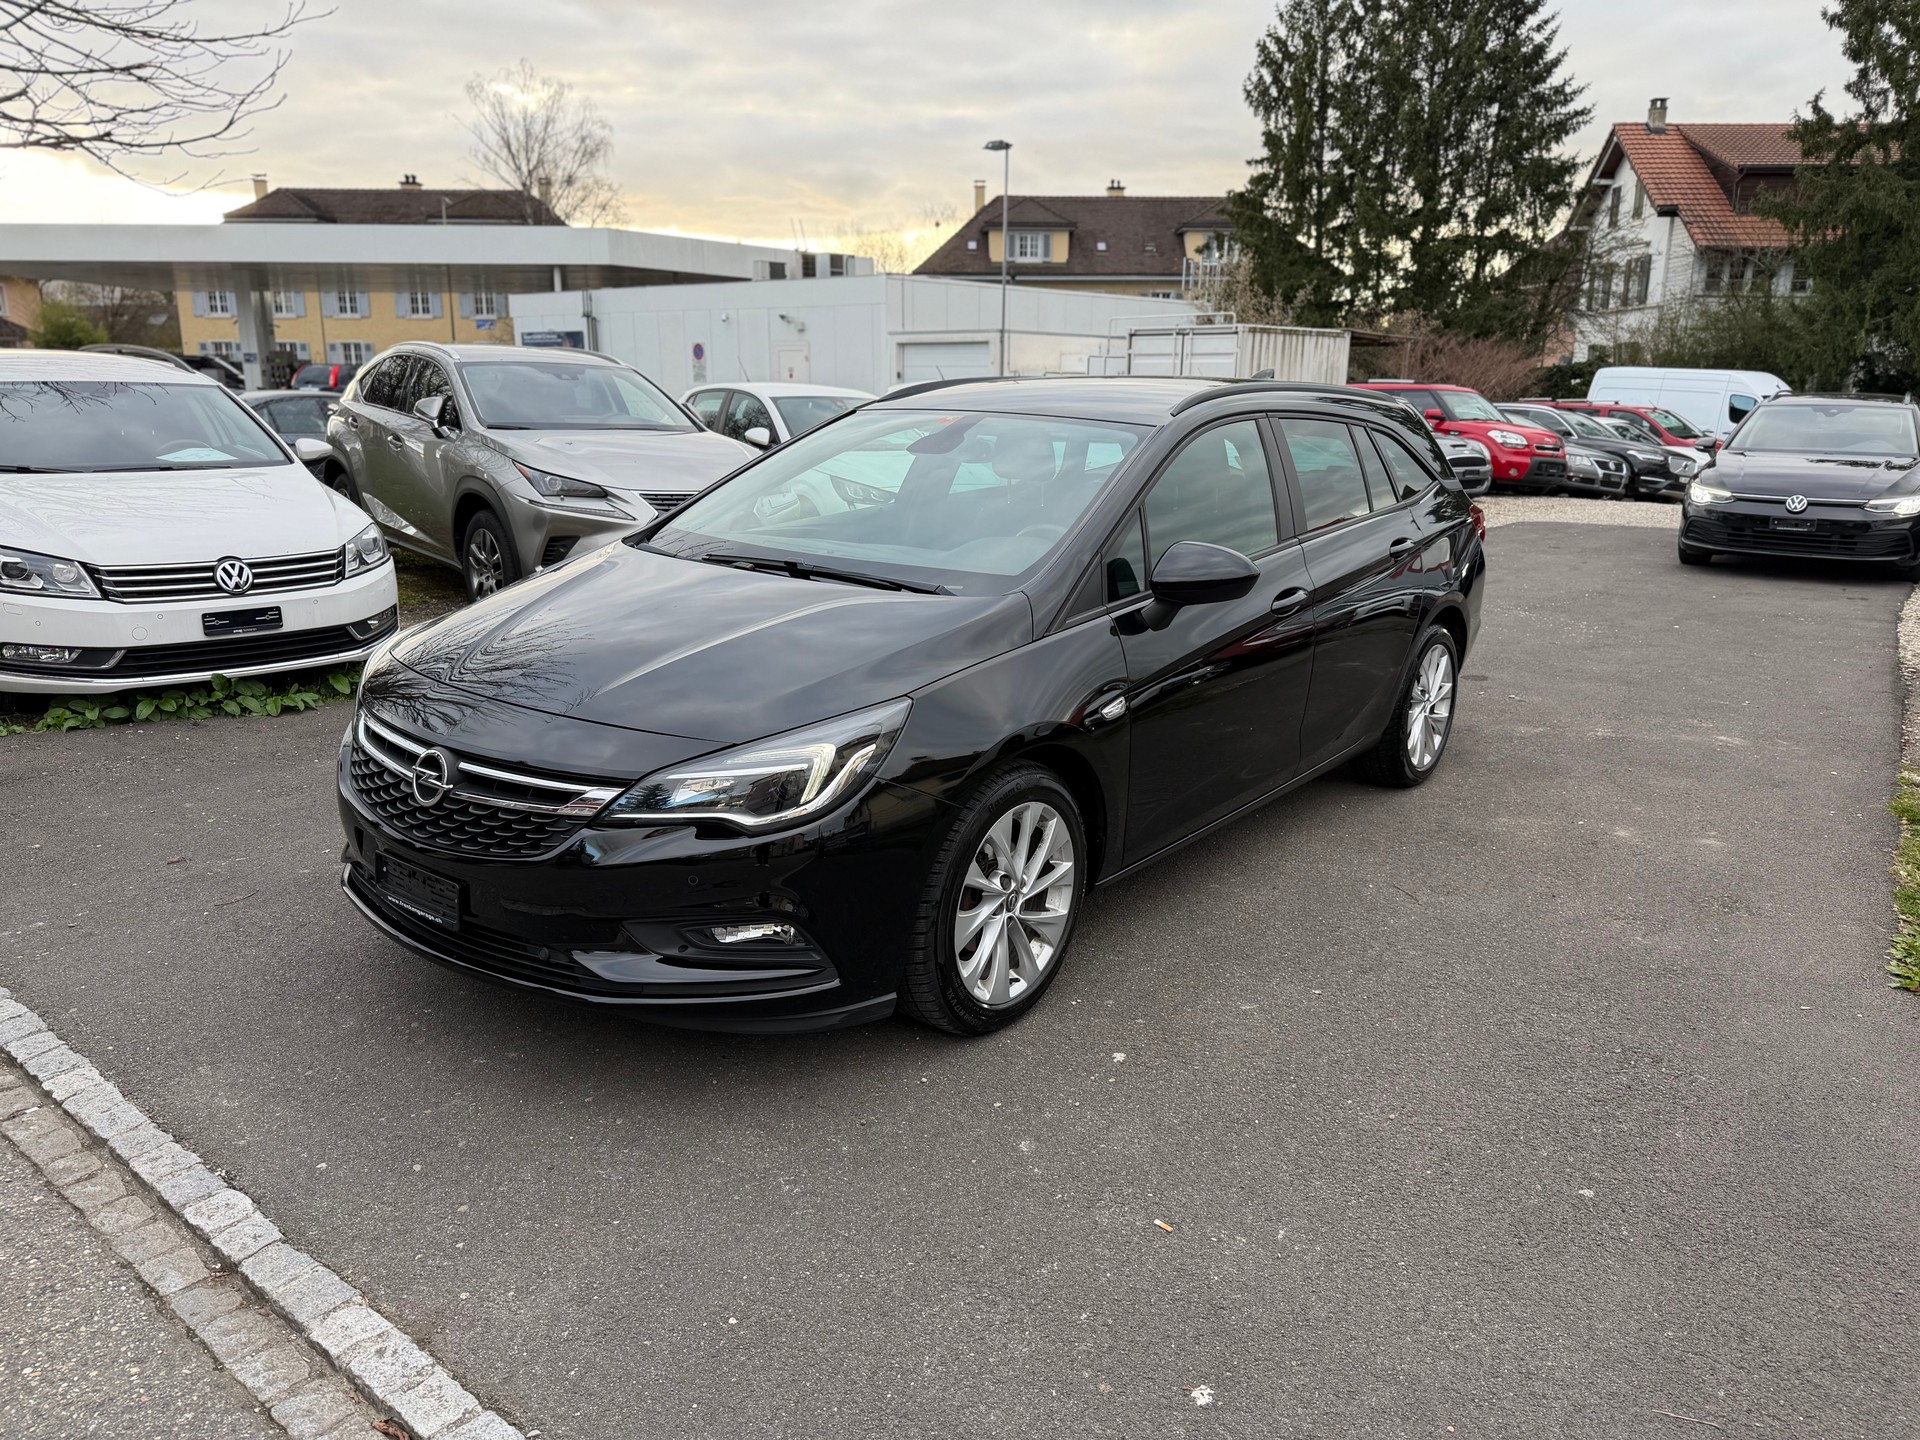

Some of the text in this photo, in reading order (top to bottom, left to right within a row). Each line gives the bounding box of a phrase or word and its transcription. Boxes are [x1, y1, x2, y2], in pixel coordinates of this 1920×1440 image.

[1786, 495, 1807, 511] VW
[217, 561, 252, 591] VW
[987, 787, 1016, 814] Barum
